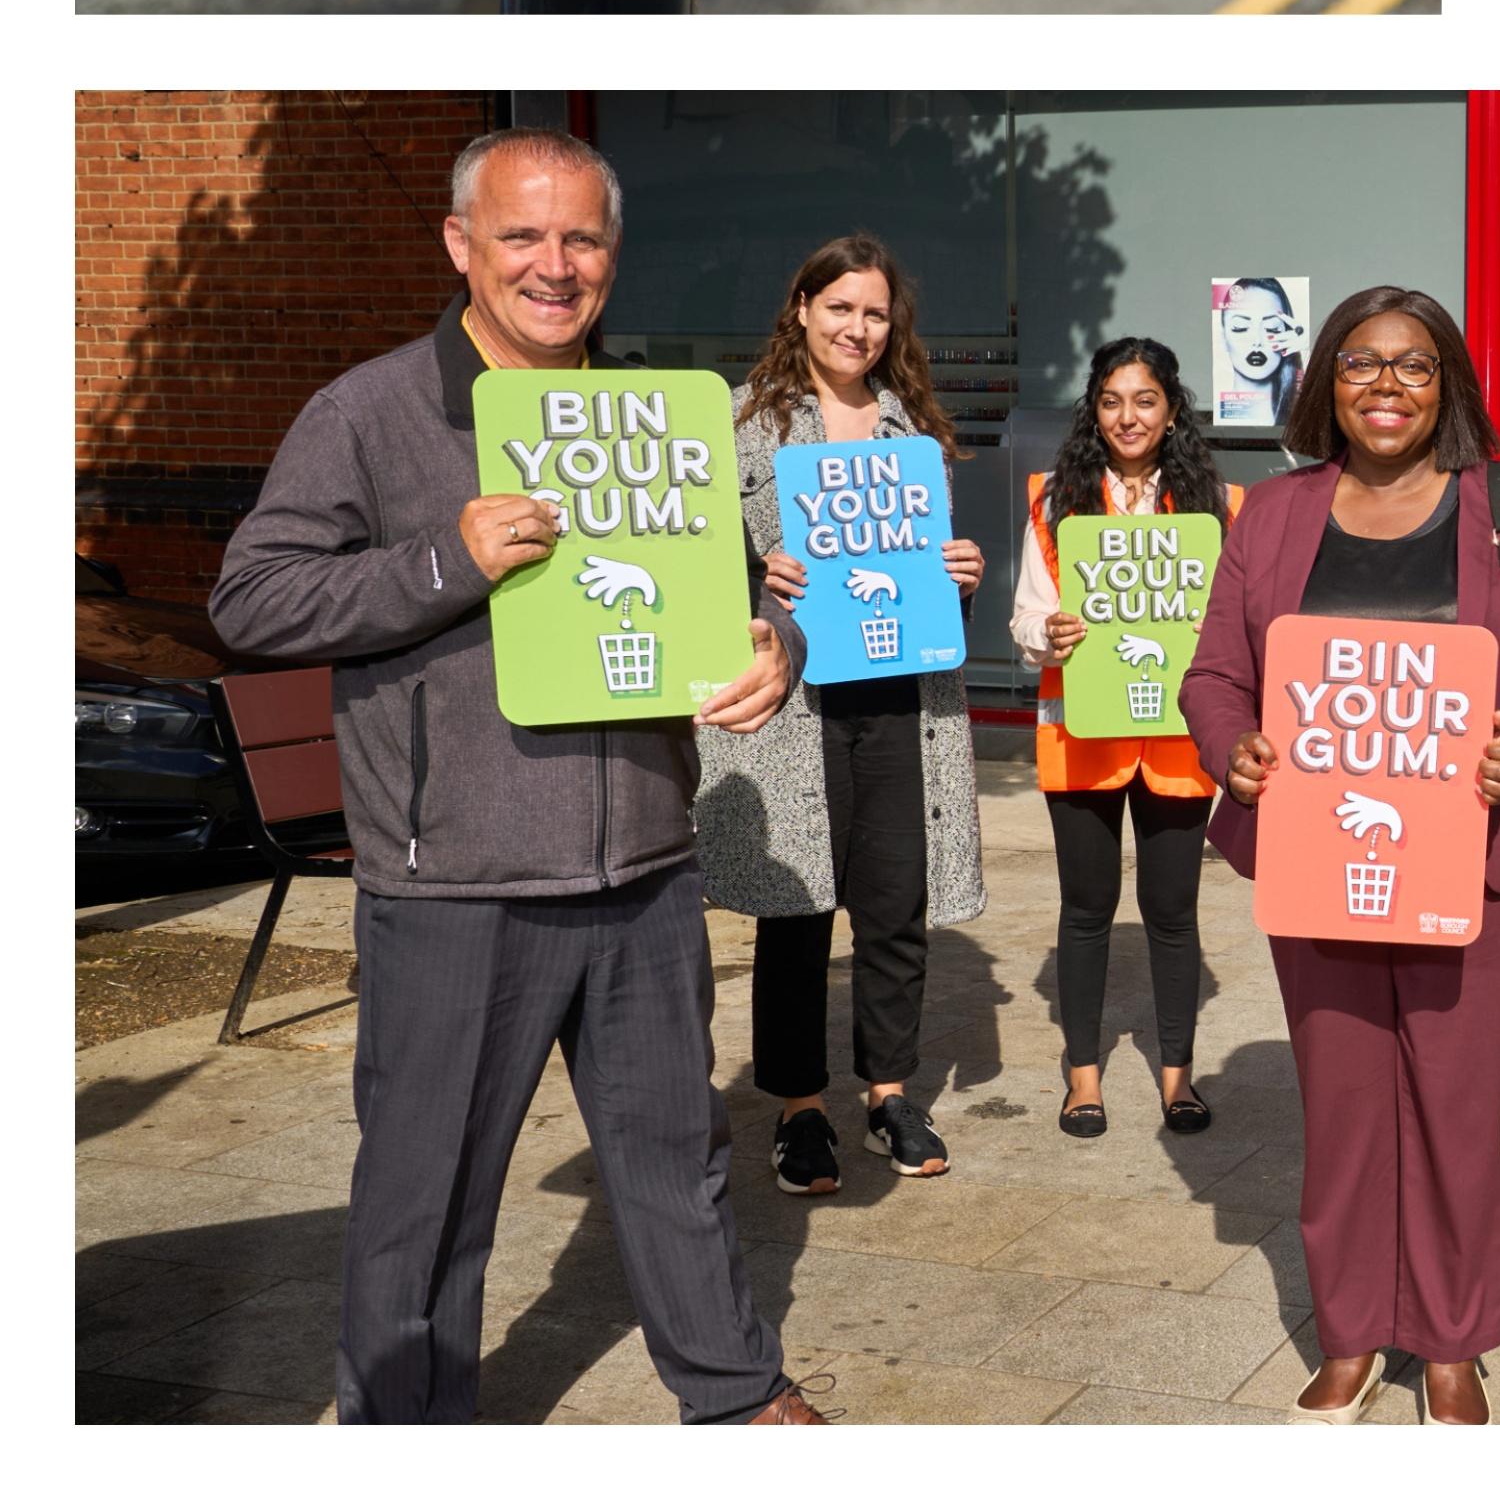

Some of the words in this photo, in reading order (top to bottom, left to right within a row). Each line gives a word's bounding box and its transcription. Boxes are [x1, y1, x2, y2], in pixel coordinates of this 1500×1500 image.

[541, 390, 668, 440] BIN
[502, 439, 712, 488] YOUR
[818, 453, 900, 491] BIN
[795, 484, 931, 526] YOUR
[806, 518, 929, 558] GUM.
[1100, 527, 1178, 560] BIN
[1075, 559, 1205, 591] YOUR
[1082, 590, 1200, 622] GUM.
[1324, 638, 1435, 687] BIN
[1285, 681, 1470, 735] YOUR
[1291, 727, 1457, 781] GUM.
